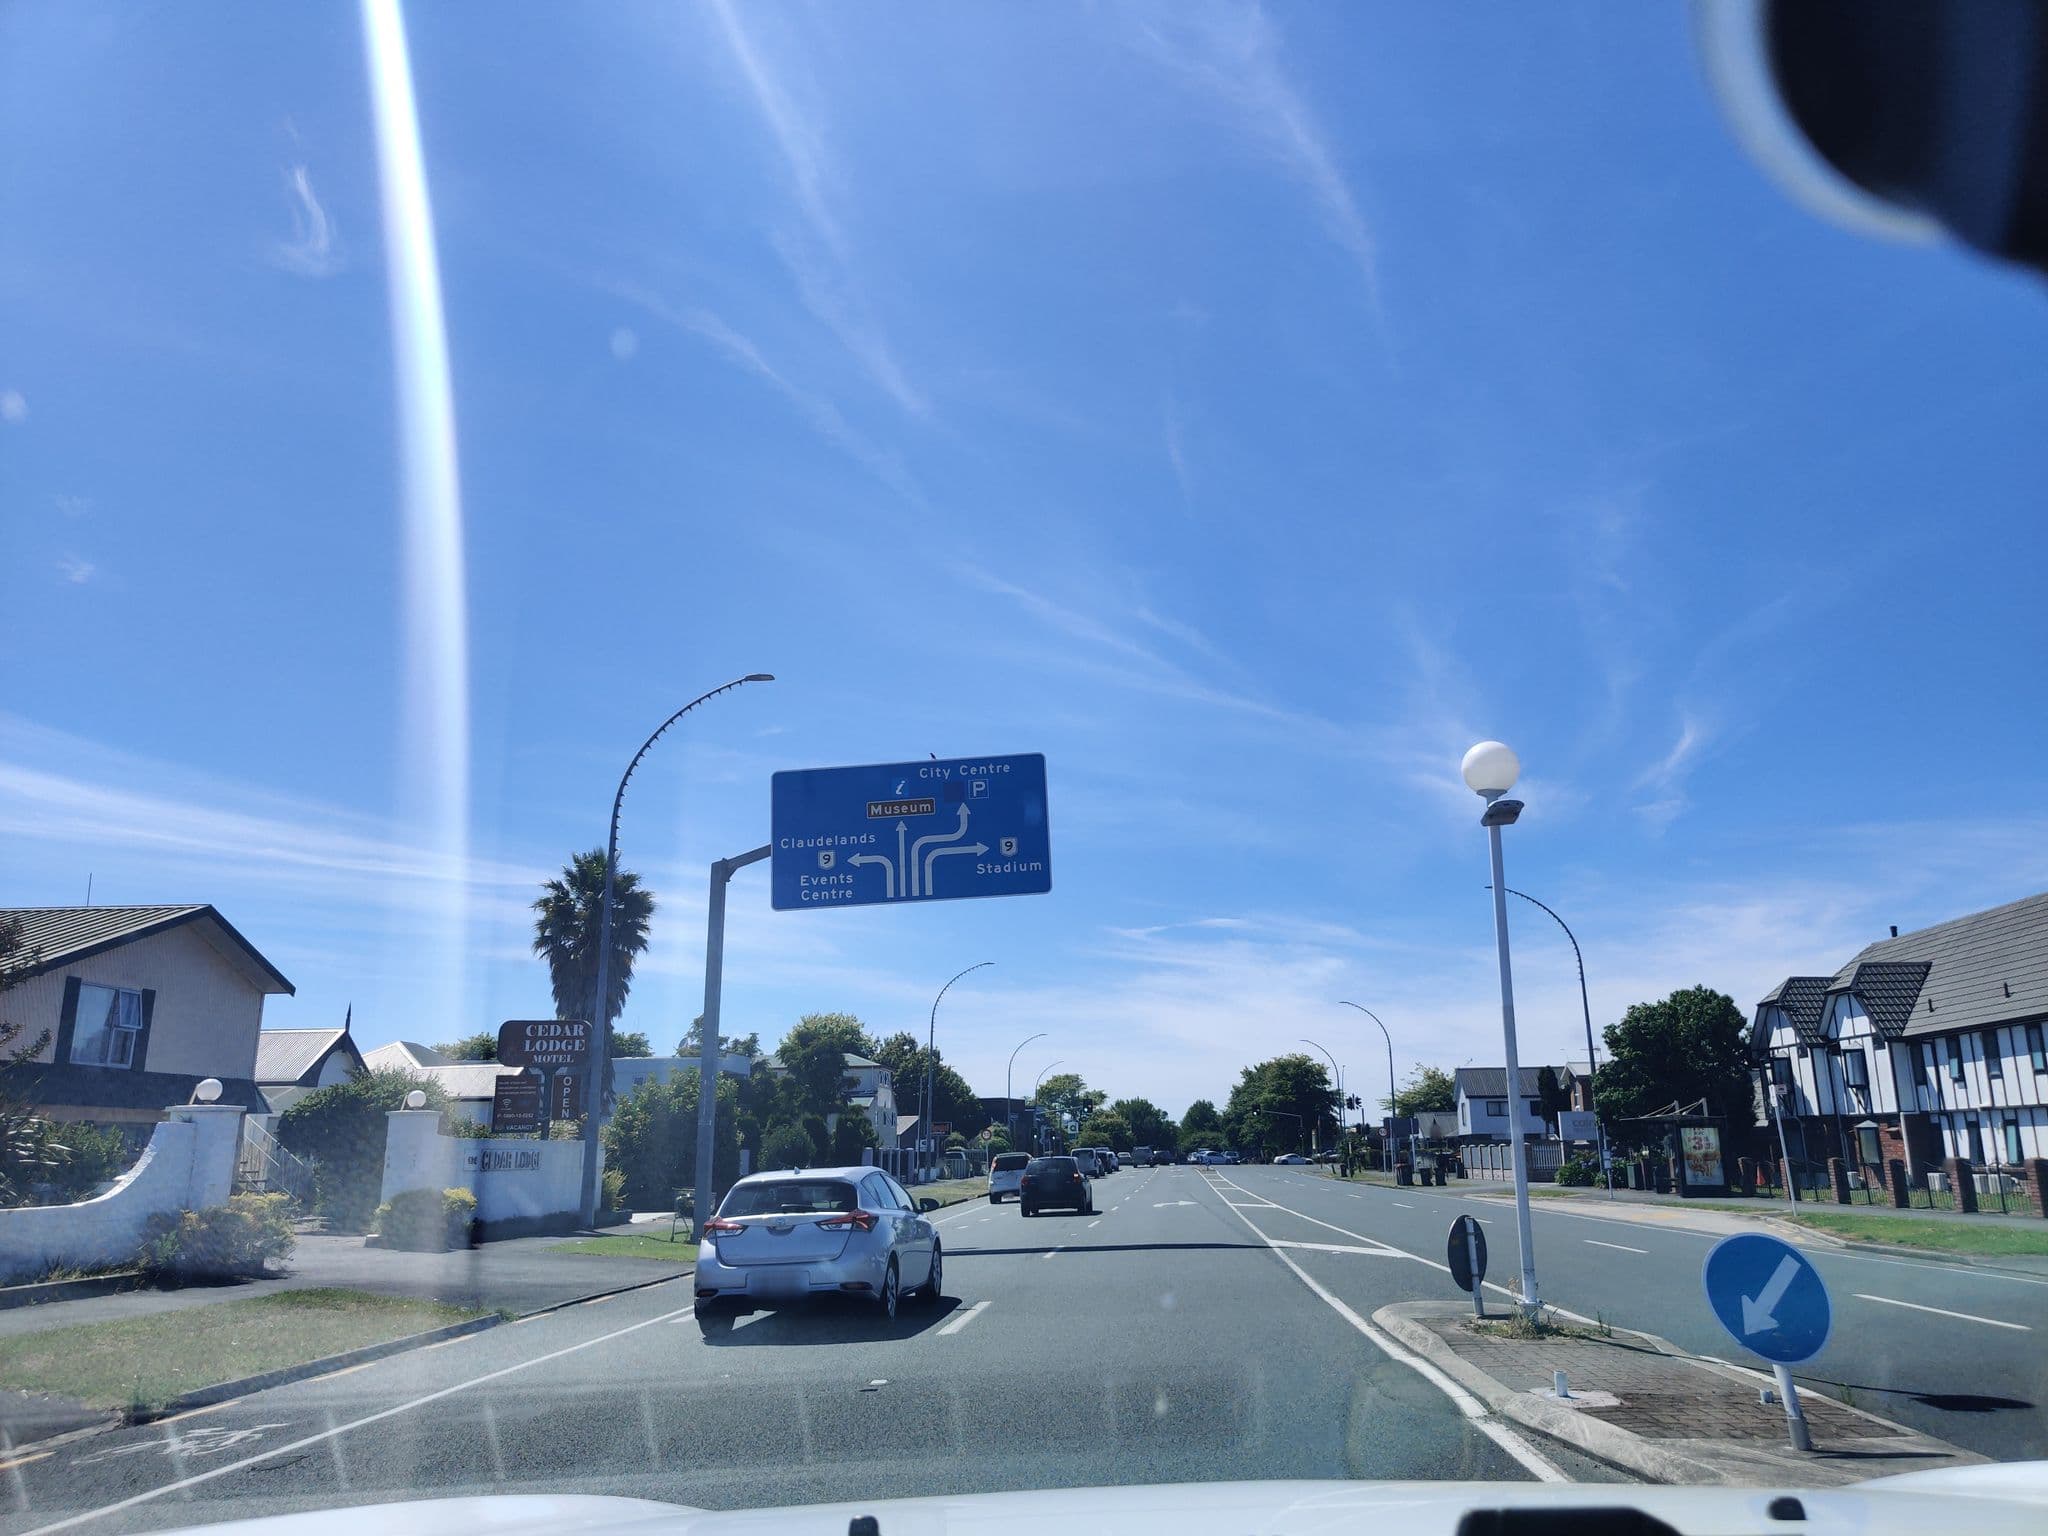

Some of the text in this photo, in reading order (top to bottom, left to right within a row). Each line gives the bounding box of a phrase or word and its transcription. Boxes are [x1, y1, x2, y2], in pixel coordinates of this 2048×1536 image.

[919, 763, 1011, 780] City Centre
[972, 781, 986, 797] P
[870, 801, 932, 816] Museum
[780, 833, 877, 849] Claudelands
[976, 860, 1043, 874] Stadium
[800, 874, 854, 886] Events
[801, 888, 853, 901] Centre
[525, 1024, 585, 1037] CEDAR
[524, 1039, 586, 1052] LODGE
[532, 1054, 574, 1063] MOTEL
[561, 1076, 573, 1118] OPEN
